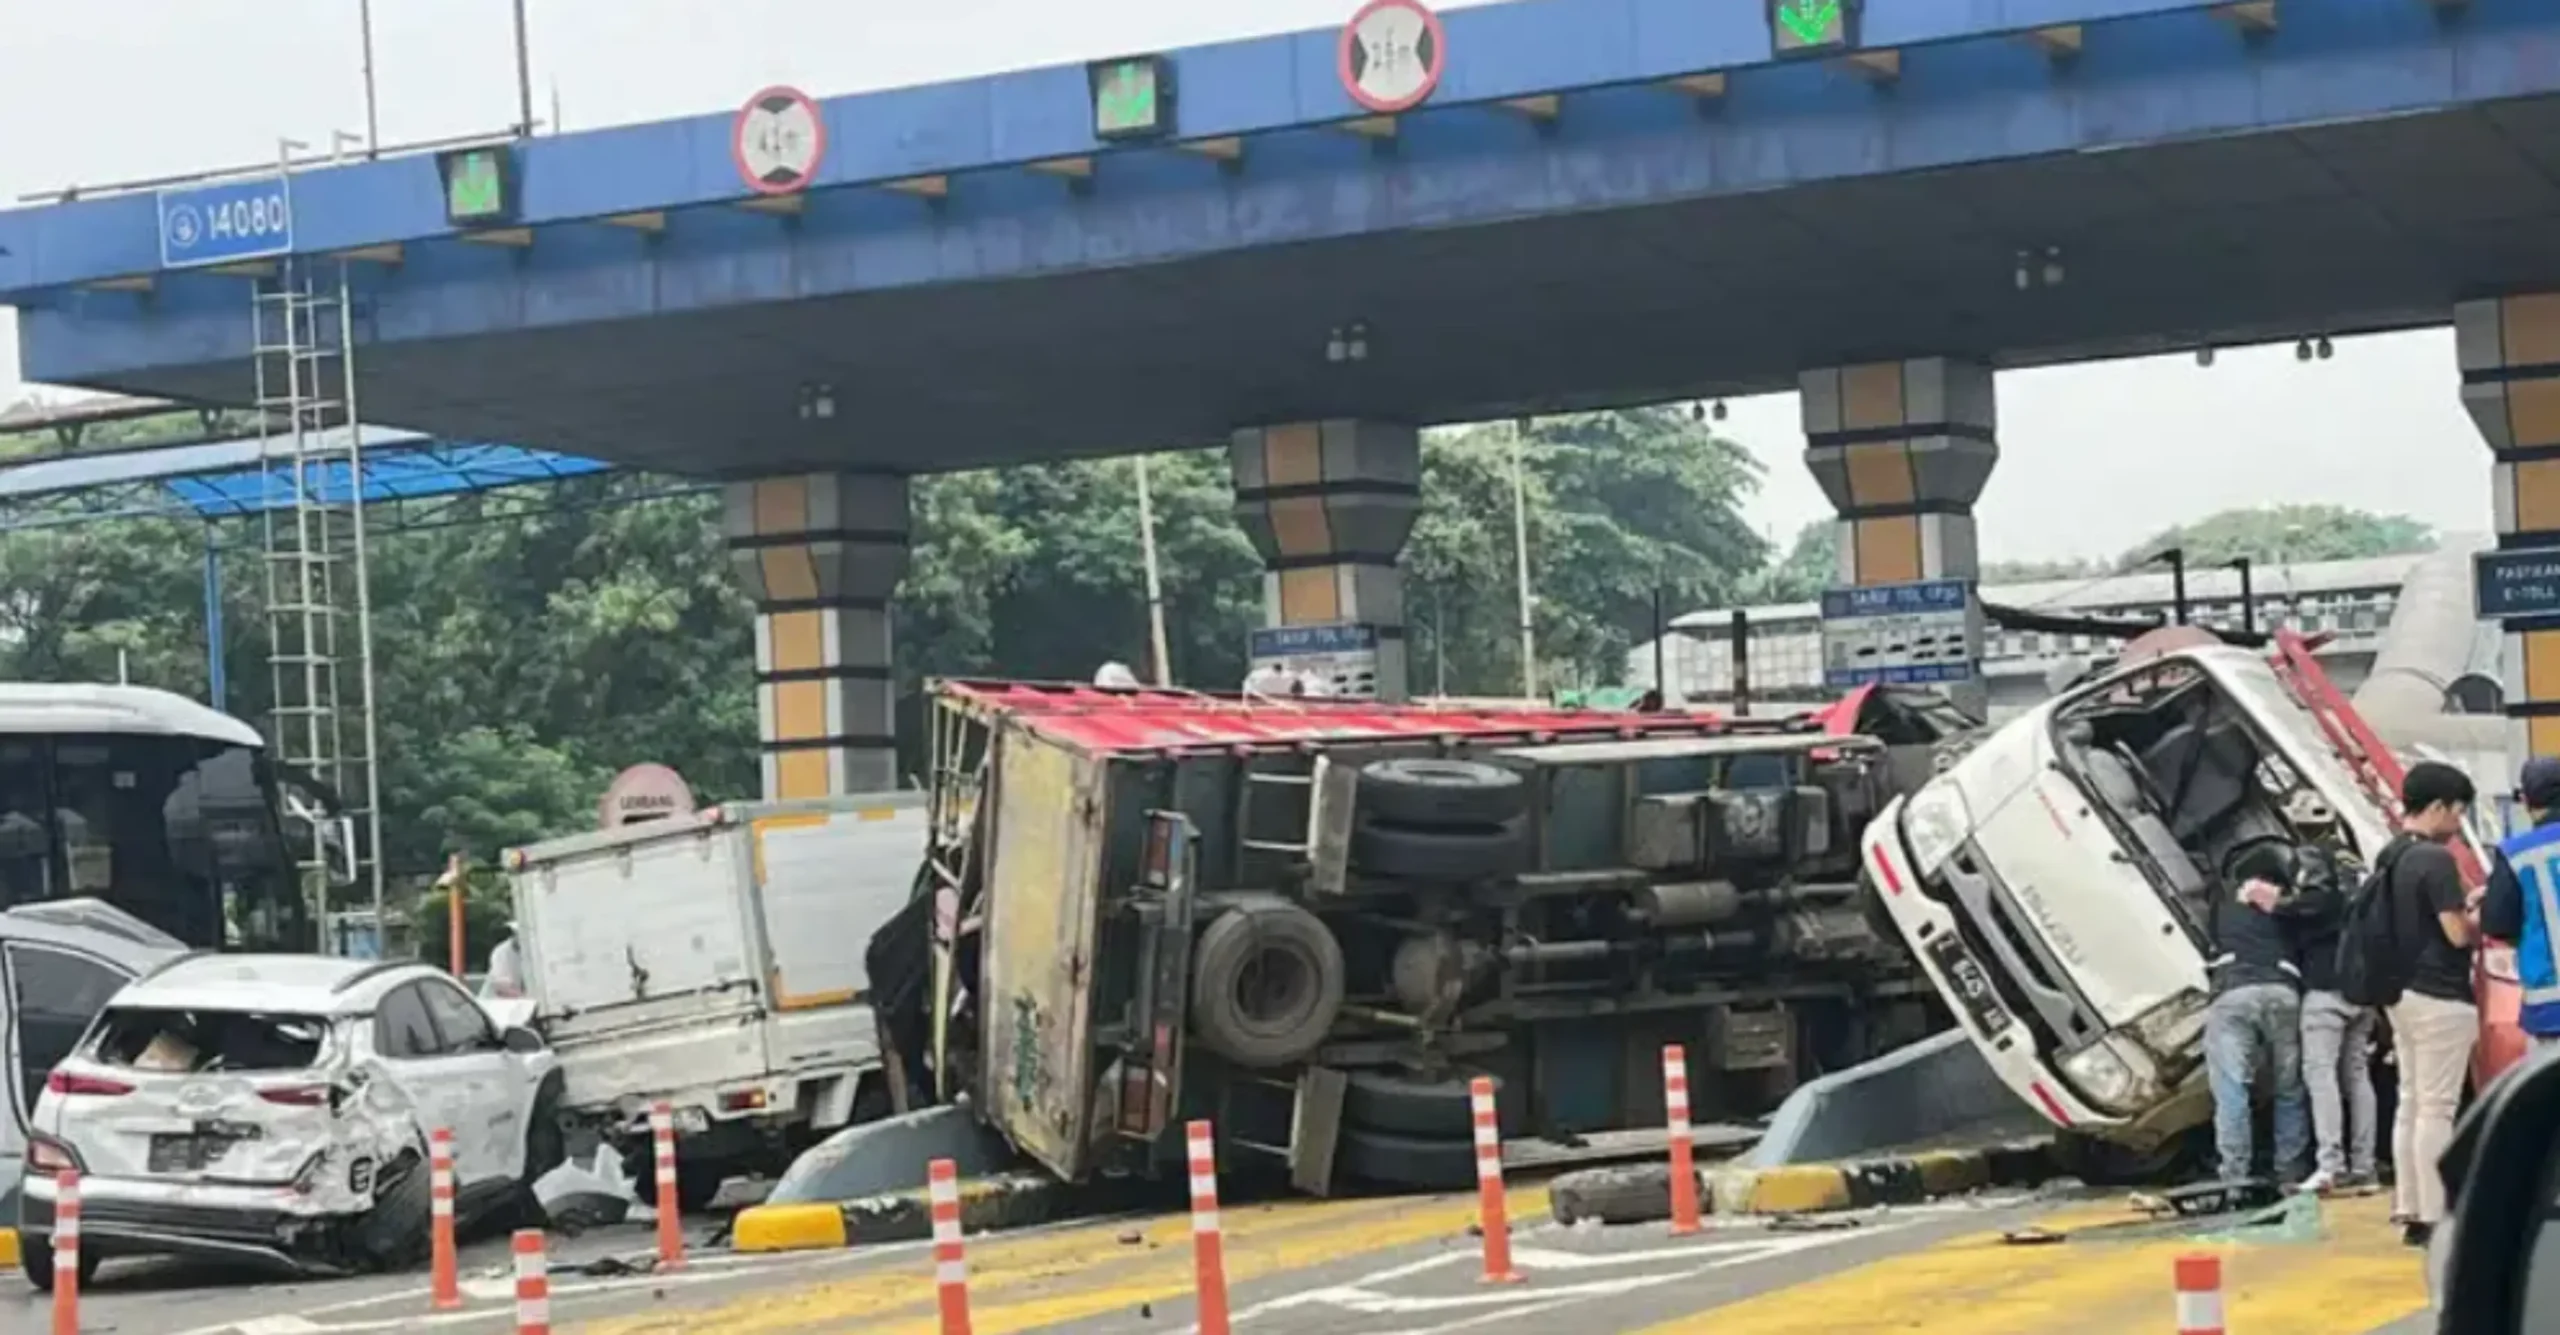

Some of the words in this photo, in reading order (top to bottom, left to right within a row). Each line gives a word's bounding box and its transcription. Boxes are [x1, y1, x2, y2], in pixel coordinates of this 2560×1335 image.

[206, 194, 285, 240] 14080
[1896, 586, 1919, 603] TOL
[2503, 584, 2556, 601] E-TOLL
